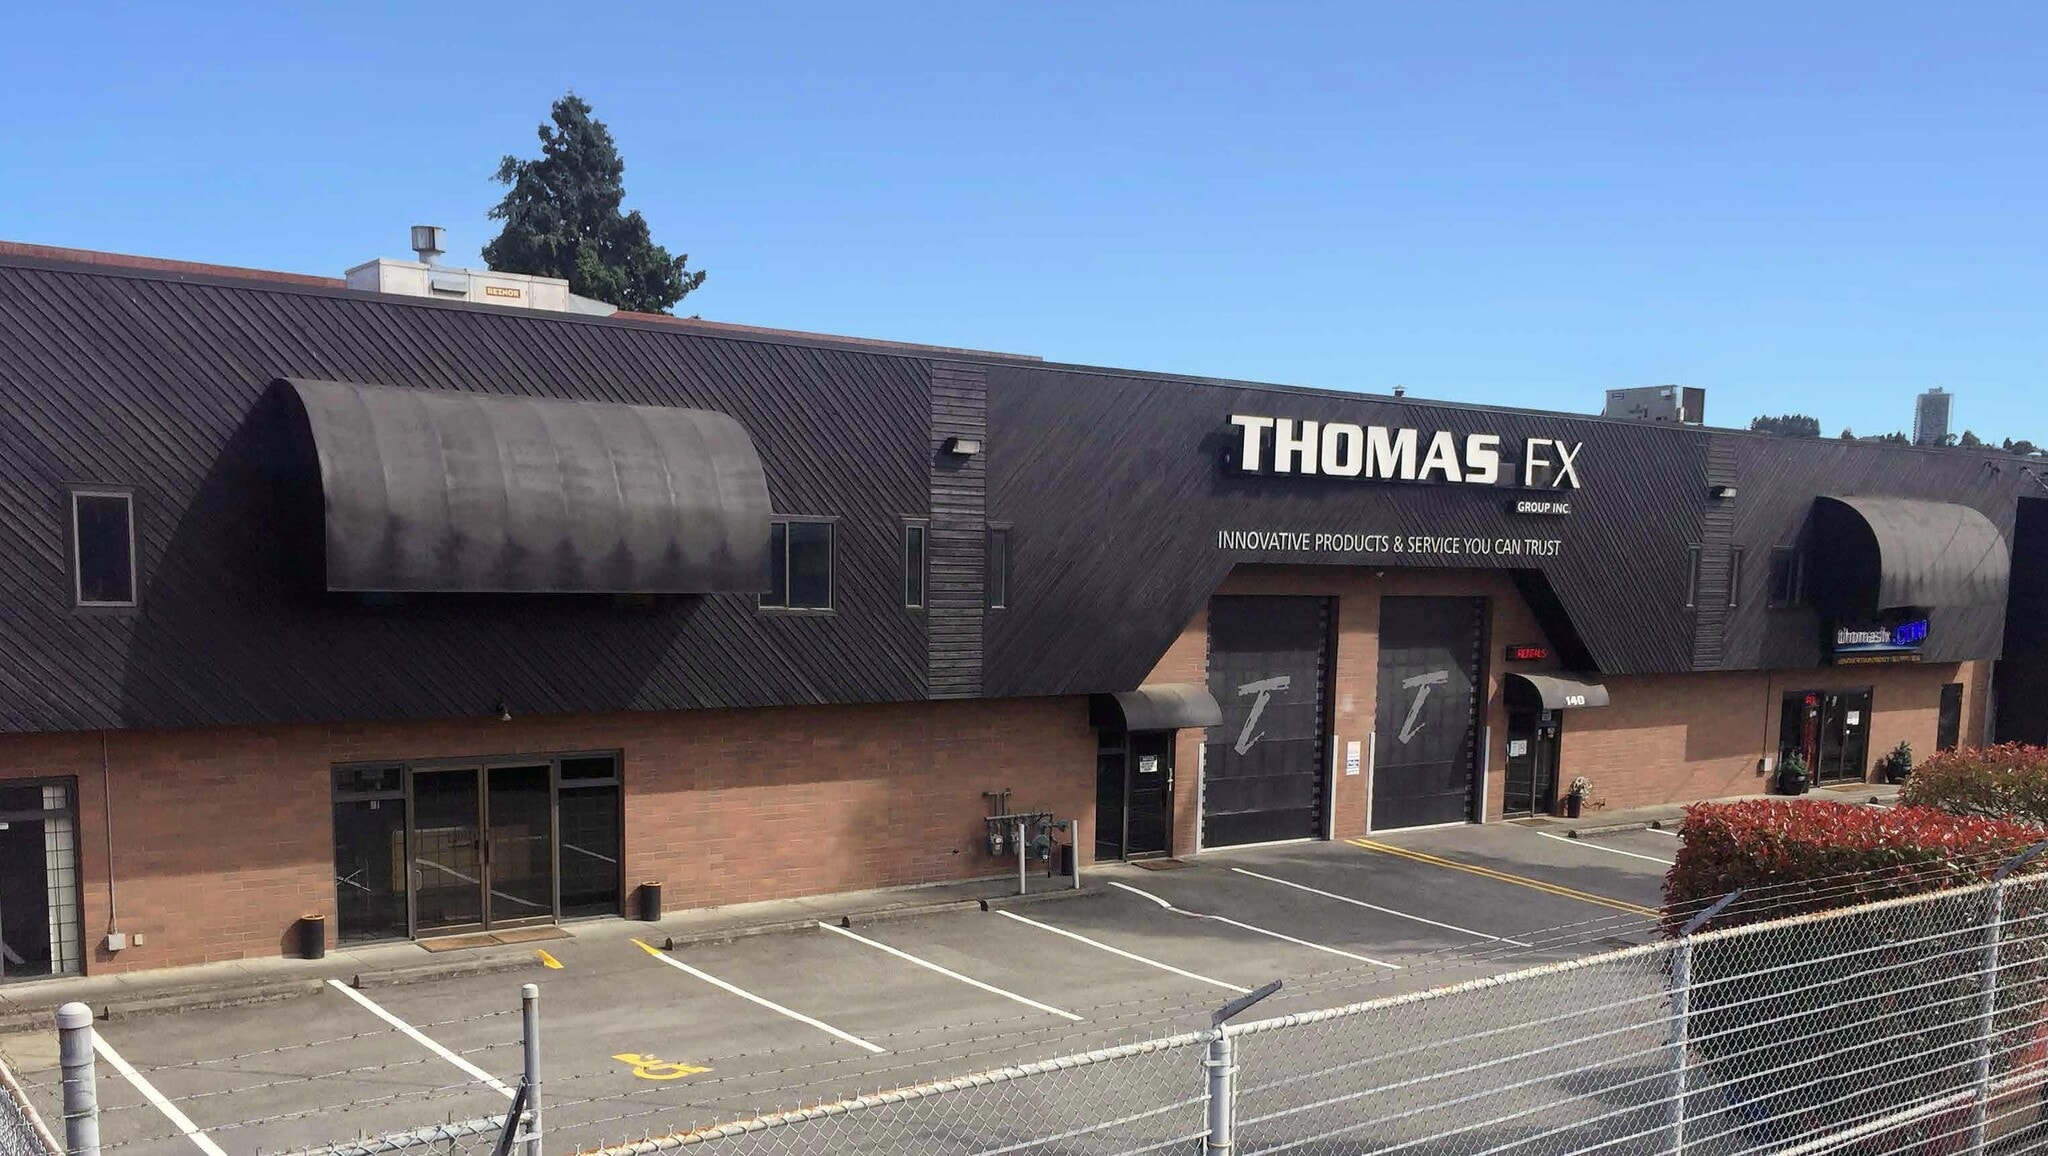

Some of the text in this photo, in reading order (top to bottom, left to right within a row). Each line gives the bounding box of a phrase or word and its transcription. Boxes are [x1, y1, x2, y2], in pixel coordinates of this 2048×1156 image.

[487, 287, 520, 298] REZNOR
[1230, 414, 1584, 490] THOMAS FX
[1517, 501, 1571, 514] GROUP INC.
[1218, 531, 1562, 556] INNOVATIVE PRODUCTS & SERVICE YOU CAN TRUST
[1565, 695, 1586, 706] 140
